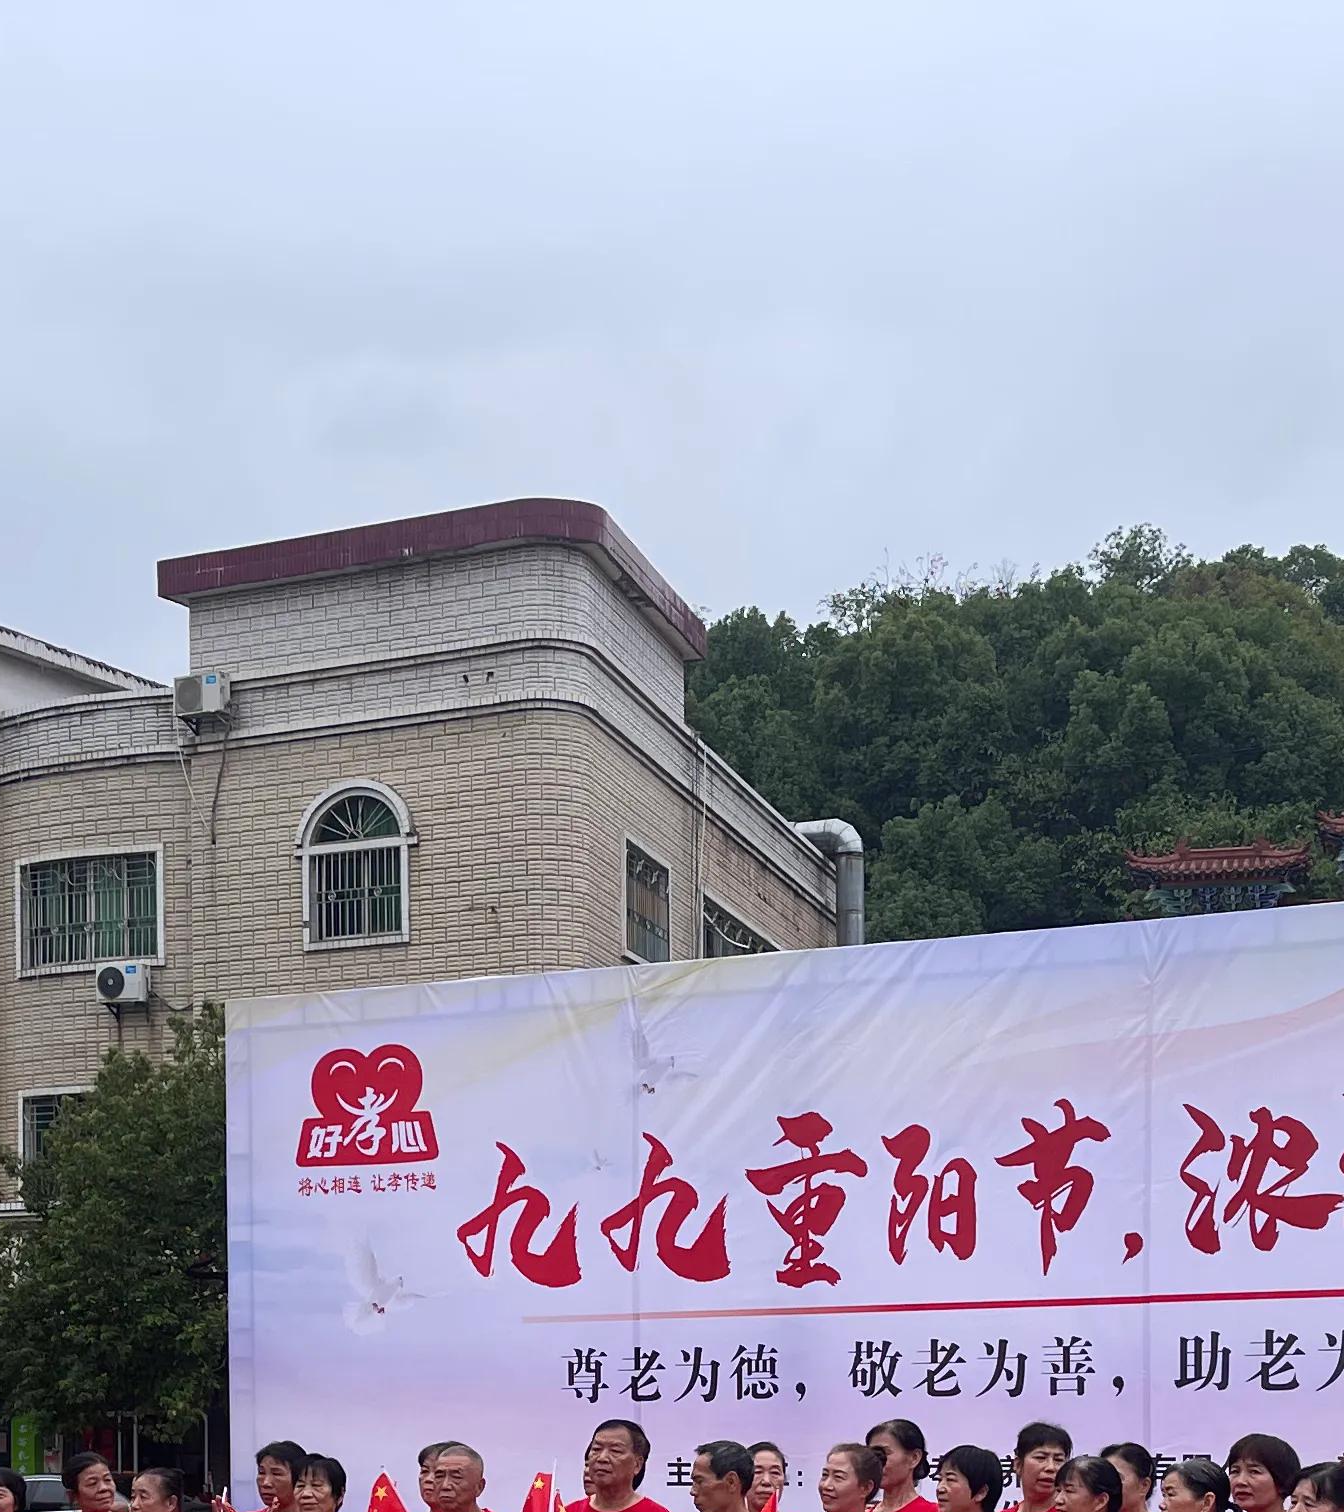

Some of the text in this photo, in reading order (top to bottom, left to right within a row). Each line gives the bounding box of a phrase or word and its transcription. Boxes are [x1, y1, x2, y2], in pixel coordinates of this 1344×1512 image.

[306, 1086, 428, 1159] 好孝心
[298, 1172, 437, 1196] 将心相连 让孝传递
